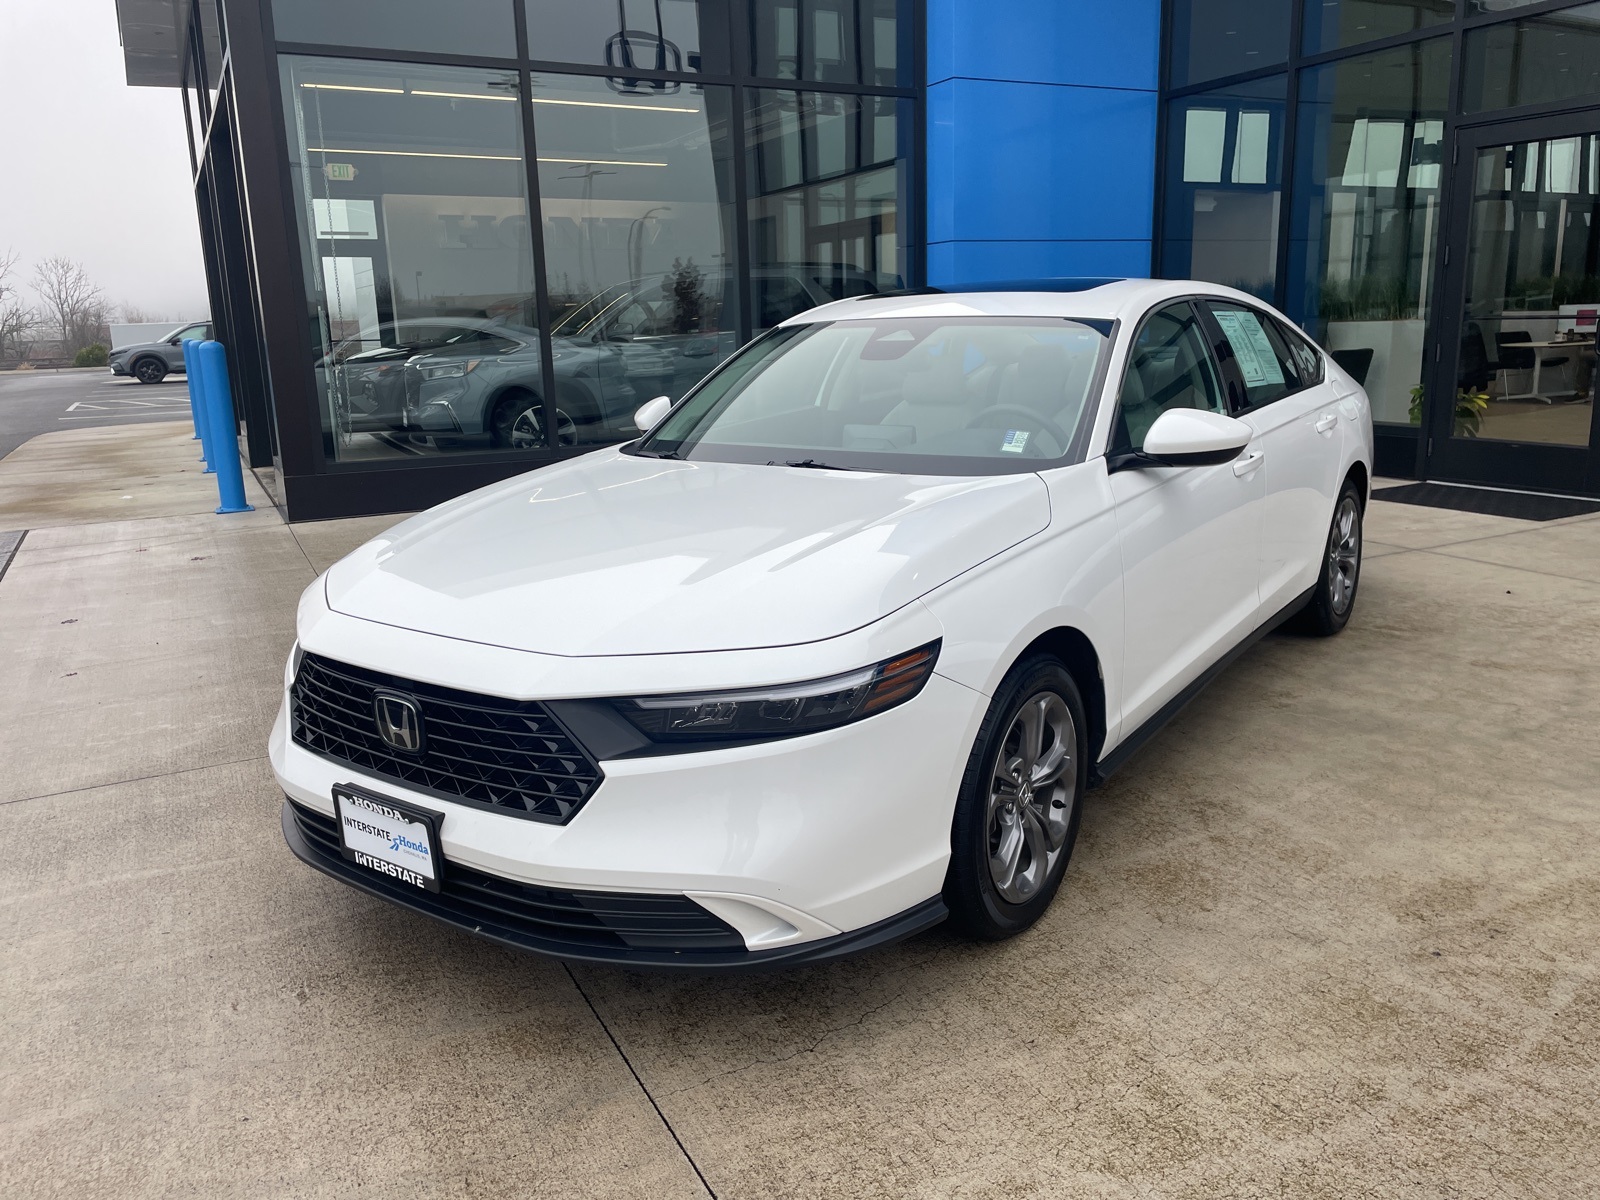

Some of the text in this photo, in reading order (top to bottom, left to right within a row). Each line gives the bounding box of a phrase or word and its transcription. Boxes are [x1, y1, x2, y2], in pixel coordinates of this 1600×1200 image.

[331, 164, 350, 178] EXIT
[351, 795, 404, 822] HONDA
[343, 816, 392, 842] INTERSTATE
[398, 834, 429, 855] Honda
[354, 851, 425, 889] INTERSTATE
